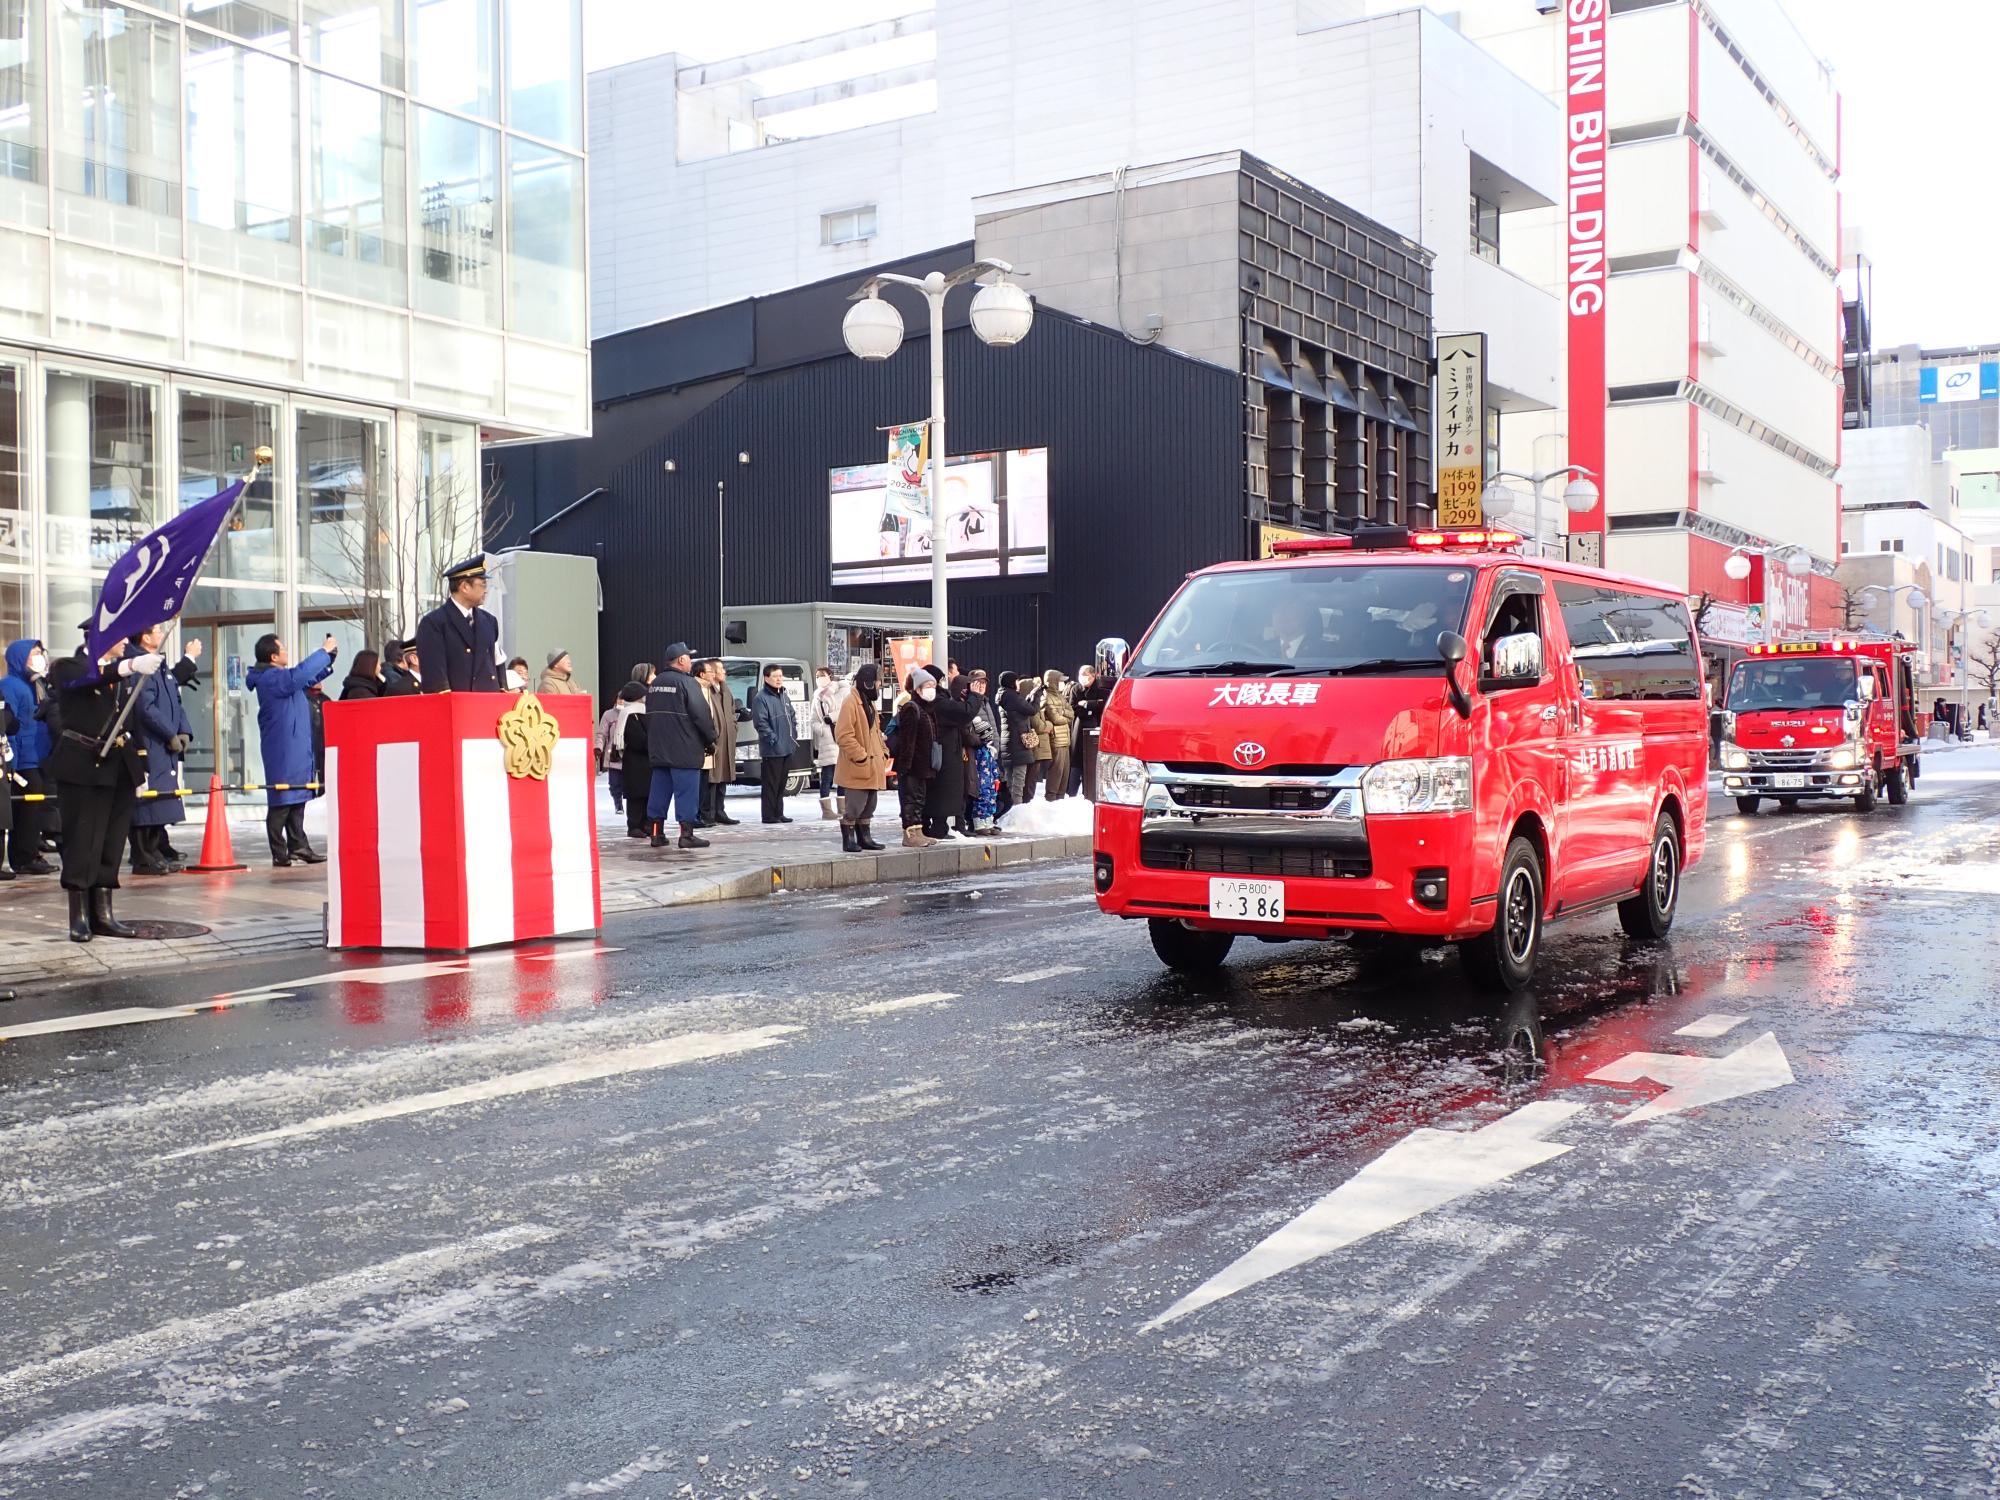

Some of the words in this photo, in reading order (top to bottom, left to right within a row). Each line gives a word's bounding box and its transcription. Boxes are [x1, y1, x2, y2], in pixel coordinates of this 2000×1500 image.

[1569, 110, 1603, 316] BUILDING
[1445, 367, 1461, 457] ミライザカ
[1443, 469, 1477, 481] ハイボール
[890, 479, 912, 491] 2026
[1443, 497, 1476, 510] 生ビール
[1208, 682, 1322, 706] 大隊長車
[1227, 882, 1267, 894] 八戸800
